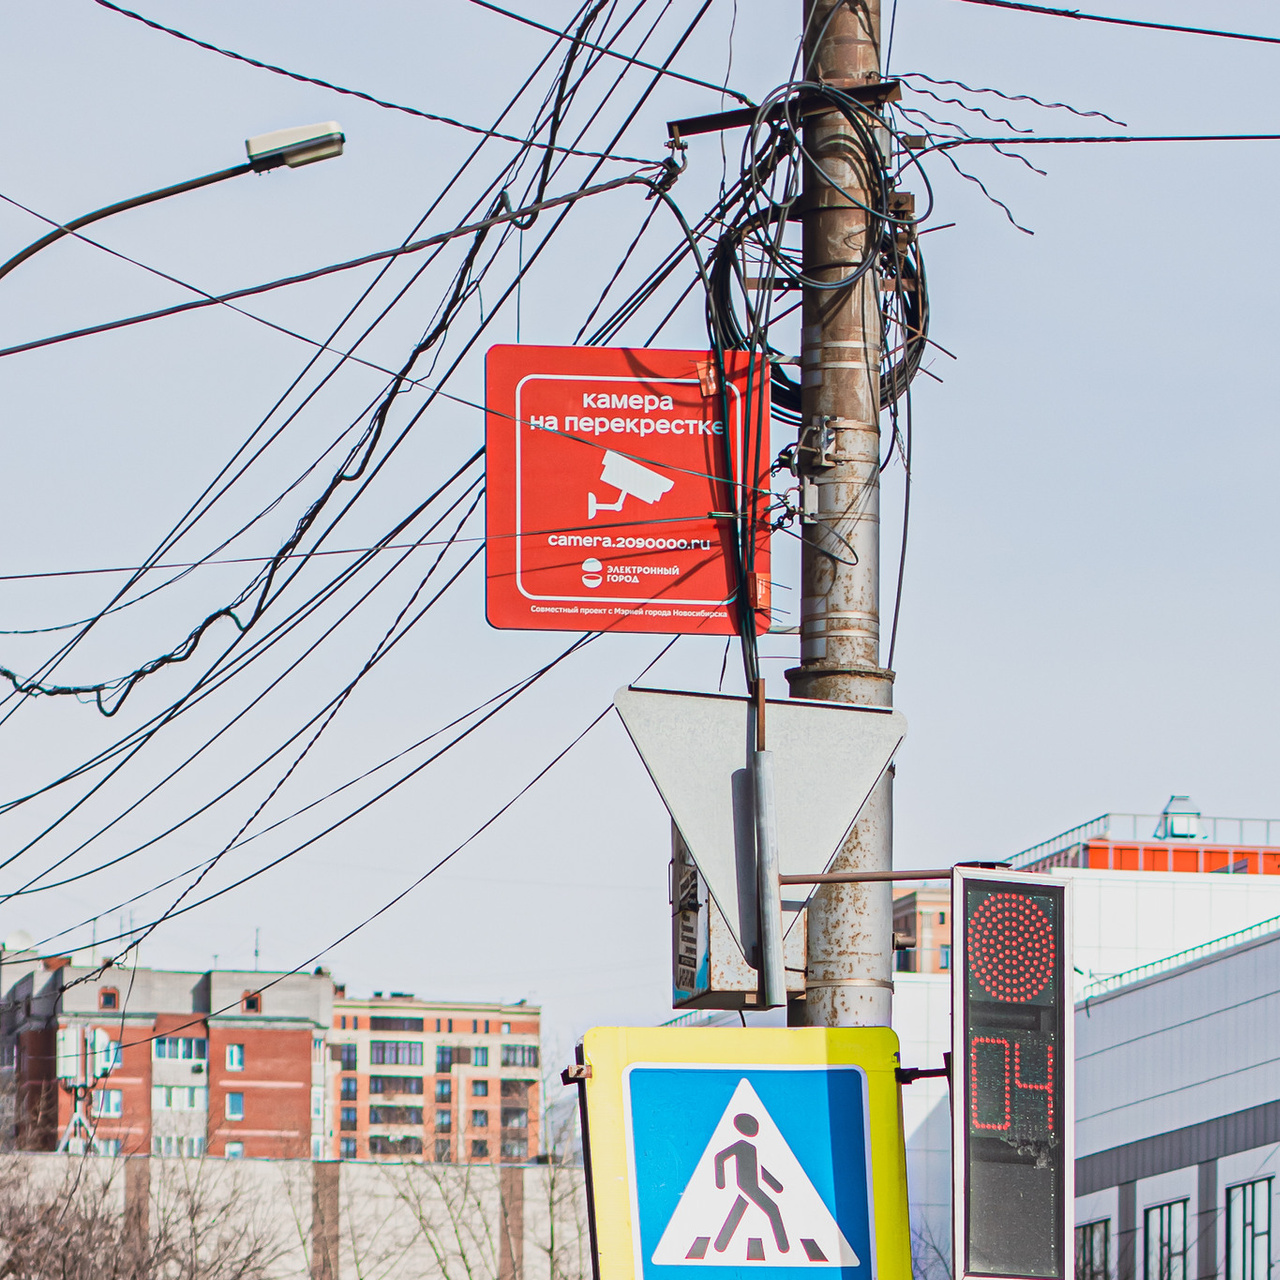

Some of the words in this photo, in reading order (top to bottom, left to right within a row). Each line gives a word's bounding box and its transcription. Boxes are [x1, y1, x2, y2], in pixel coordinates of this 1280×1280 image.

[583, 392, 673, 413] камера
[530, 414, 558, 431] на
[564, 415, 724, 437] перекрестке
[547, 534, 711, 551] camera.2090000.ru
[606, 565, 680, 576] ЭЛЕКТРОННЫЙ
[606, 574, 640, 584] ГОРОД
[530, 604, 579, 614] Совместный
[579, 607, 607, 616] проект
[644, 608, 672, 618] города
[672, 609, 728, 619] Новосибирска
[971, 1035, 1054, 1131] 04
